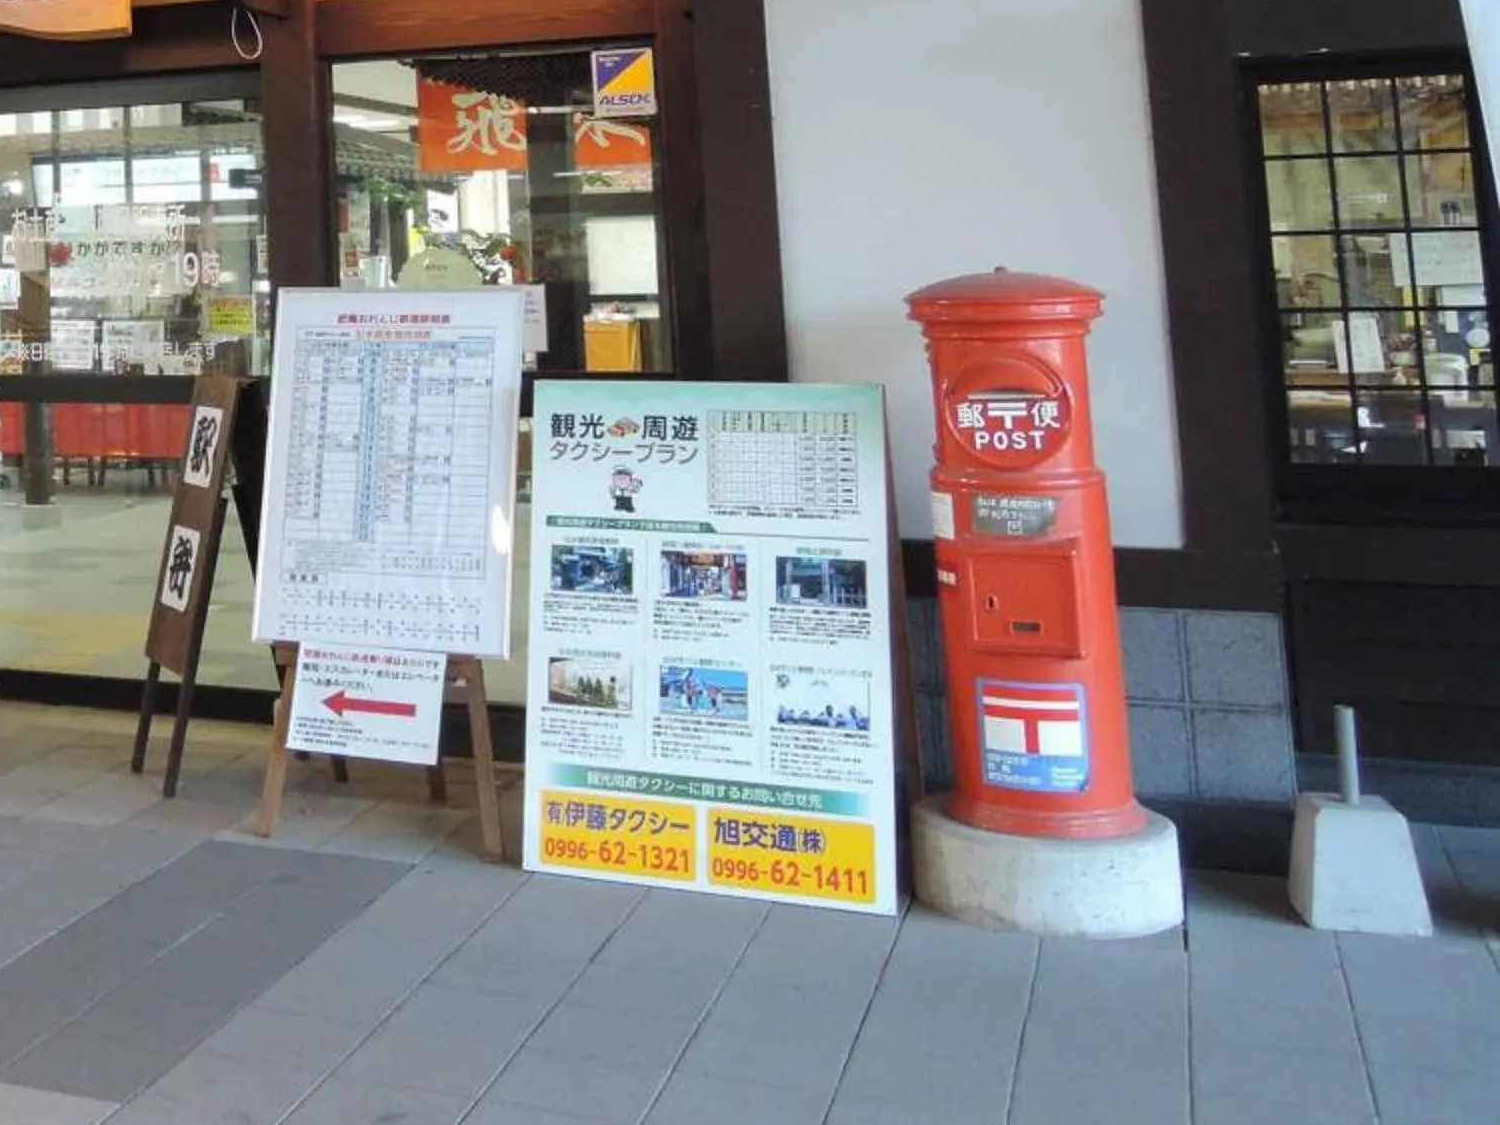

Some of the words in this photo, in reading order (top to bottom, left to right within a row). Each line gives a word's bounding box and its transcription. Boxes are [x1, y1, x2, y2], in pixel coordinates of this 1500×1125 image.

[600, 94, 651, 106] ALSOK
[550, 440, 699, 465] タクシープラン
[975, 431, 1045, 450] POST
[545, 837, 690, 873] 0996-62-1321
[713, 855, 868, 895] 0996-62-1411
